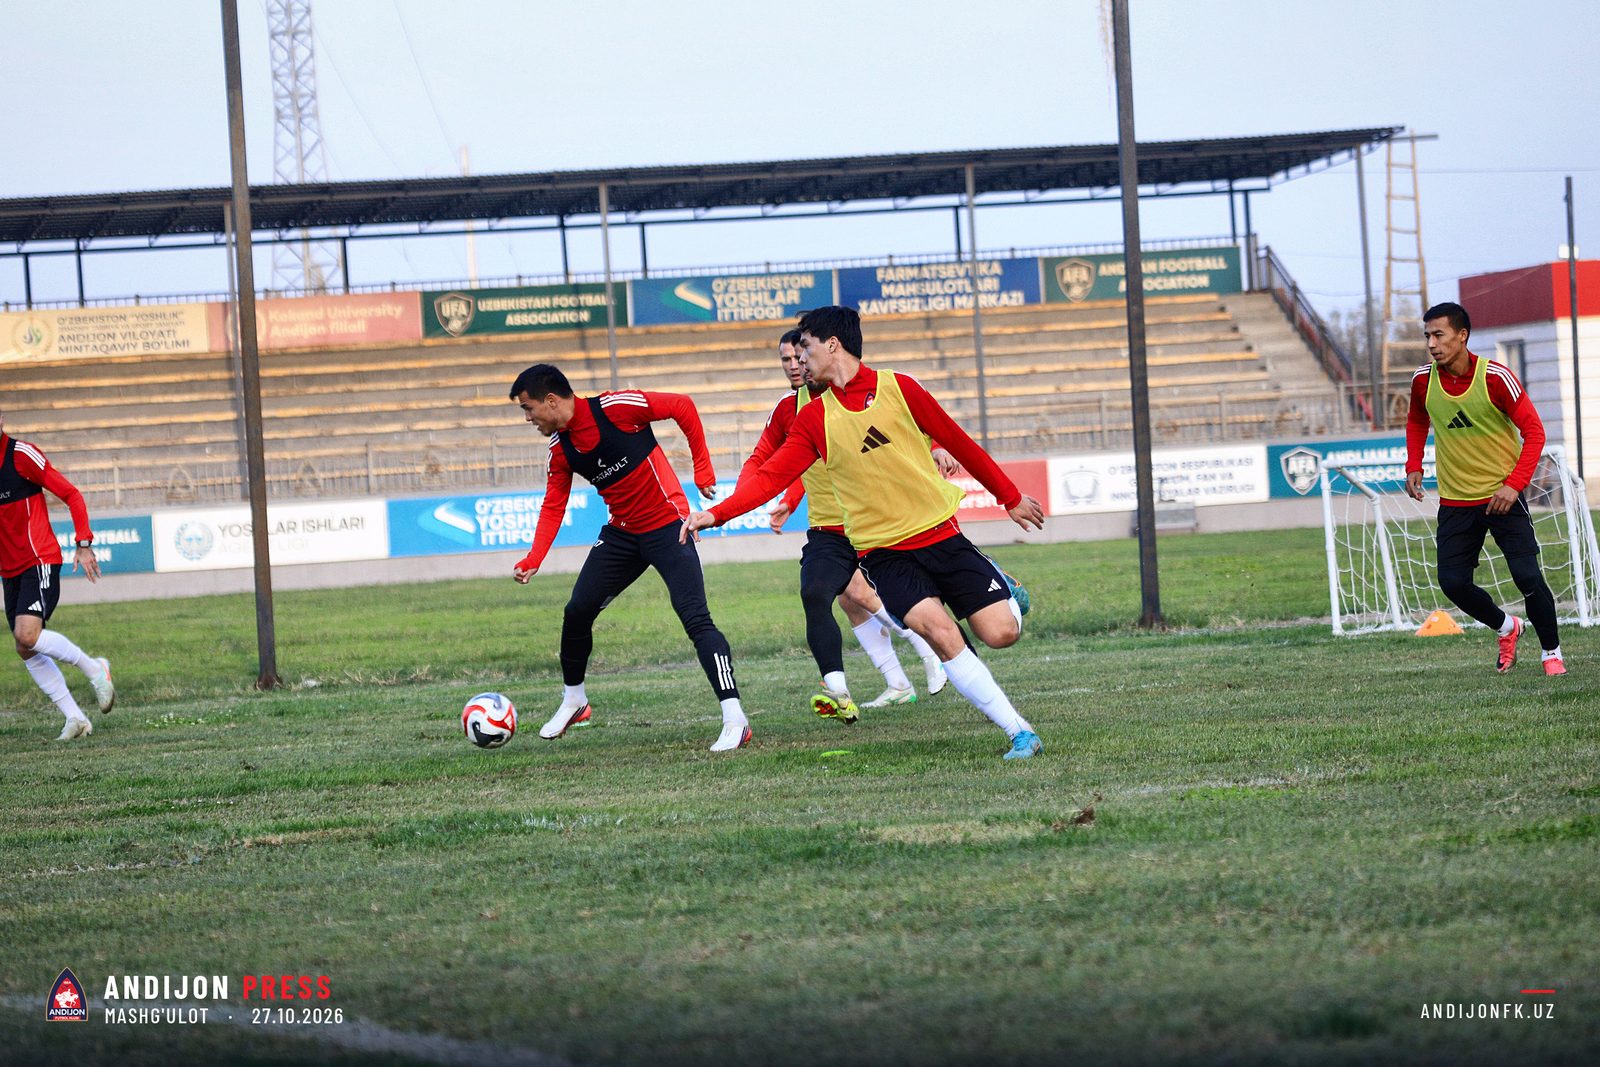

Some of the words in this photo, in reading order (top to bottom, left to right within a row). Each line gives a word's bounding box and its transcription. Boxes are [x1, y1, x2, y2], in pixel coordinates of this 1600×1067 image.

[1099, 260, 1157, 276] ANDAN
[1160, 256, 1227, 273] FOOTBALL
[712, 273, 814, 293] O'ZBEKISTON
[1118, 274, 1209, 292] AOCIATION
[477, 297, 549, 312] UZBEKISTAN
[712, 289, 800, 308] YOSHLAR
[327, 304, 403, 319] University
[505, 310, 590, 326] ASSOCIATION
[717, 305, 784, 321] ITTIFOQI
[59, 333, 116, 343] ANDIJON
[120, 329, 176, 340] VILOYATI
[59, 342, 138, 354] MINTAQAVIY
[302, 517, 364, 533] ISHLARI
[481, 528, 535, 546] ITTIFO
